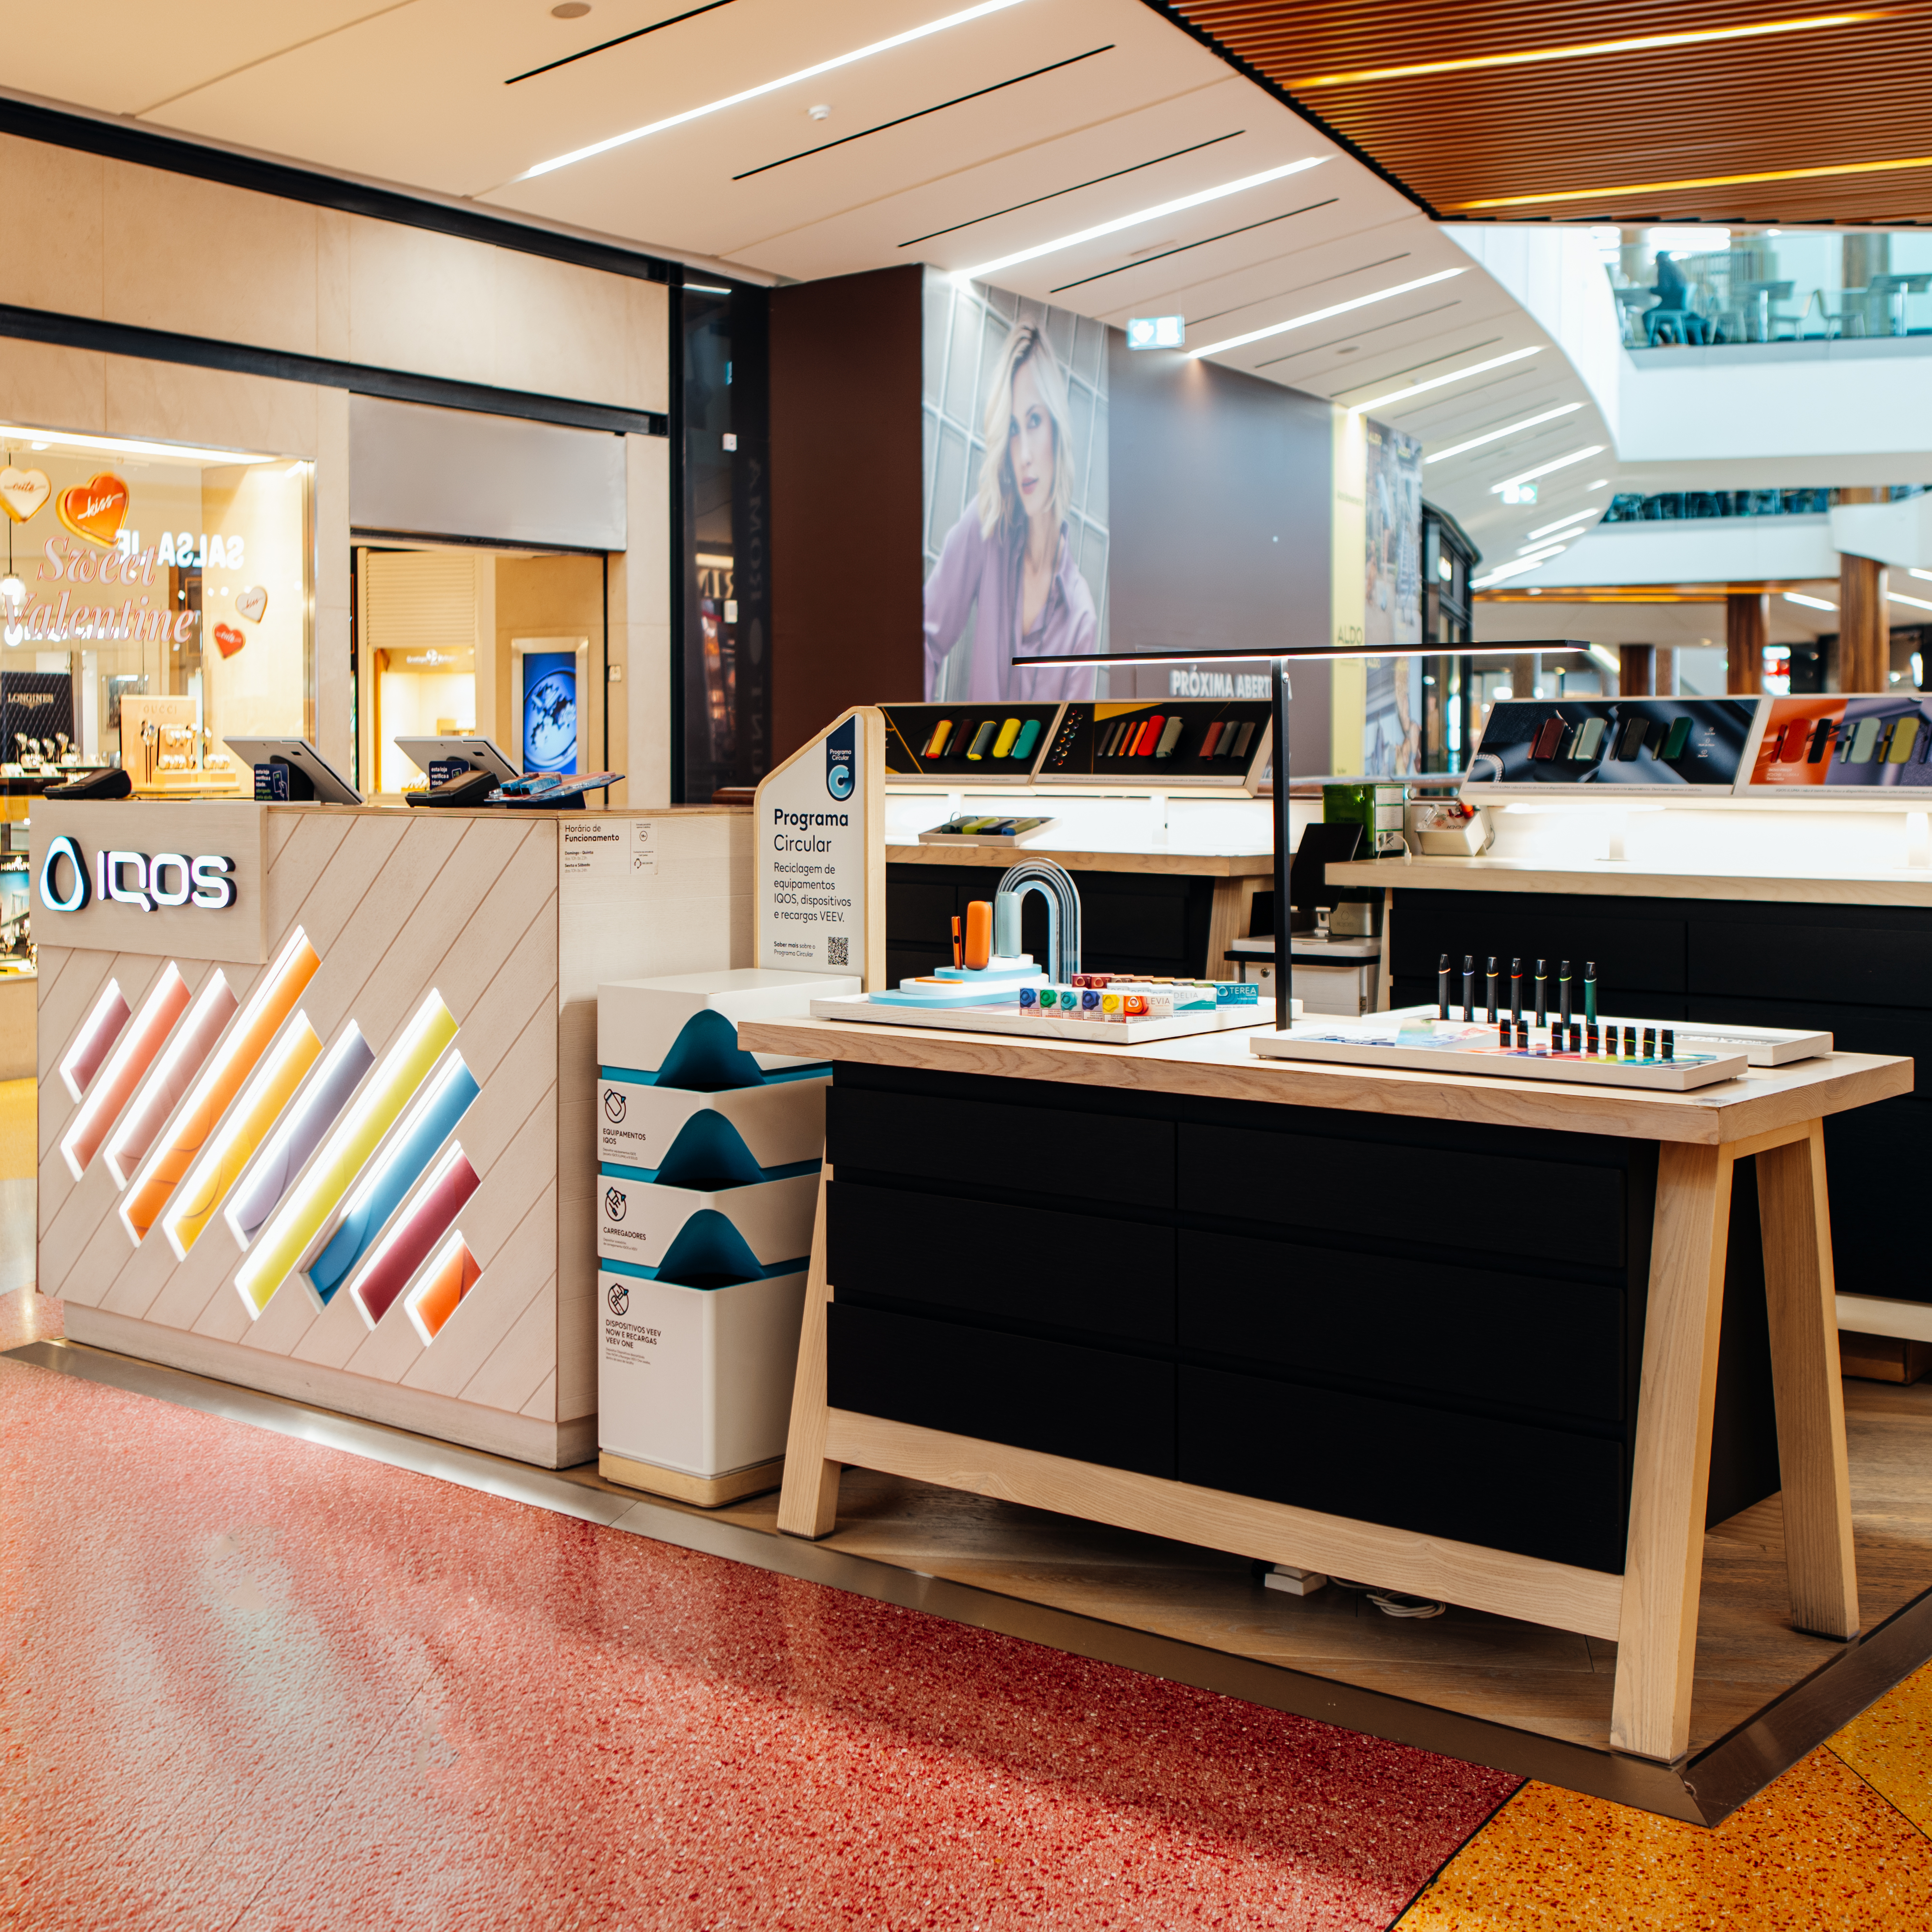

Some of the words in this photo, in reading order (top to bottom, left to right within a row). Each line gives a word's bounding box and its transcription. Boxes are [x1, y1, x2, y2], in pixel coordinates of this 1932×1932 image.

[78, 492, 123, 519] kiss
[37, 534, 159, 587] Sweet
[242, 597, 264, 610] kiss
[1, 589, 196, 643] Valentine
[1338, 625, 1363, 645] ALDO
[1170, 664, 1234, 697] PRÓXIMA
[8, 692, 54, 704] LONGINES
[144, 705, 178, 715] GUCCI
[774, 808, 849, 831] Programa
[565, 824, 591, 833] Horário
[592, 824, 601, 832] de
[565, 834, 620, 842] Funcionamento
[774, 834, 832, 852] Circular
[774, 862, 822, 876] Reciclagem
[824, 864, 835, 874] de
[97, 850, 235, 912] IQOS
[774, 879, 835, 891] equipamentos
[774, 893, 799, 906] IQOS,
[801, 894, 851, 908] dispositivos
[774, 910, 779, 919] e
[781, 911, 818, 923] recargas
[820, 911, 845, 923] VEEV.
[774, 949, 796, 958] Programa
[603, 1128, 646, 1140] EQUIPAMENTOS
[604, 1227, 647, 1240] CARREGADORES
[606, 1319, 645, 1334] DISPOSITIVOS
[646, 1328, 662, 1337] VEEV
[606, 1328, 620, 1337] NOW
[626, 1332, 657, 1345] RECARGAS
[606, 1336, 620, 1346] VEEV
[621, 1340, 634, 1349] ONE
